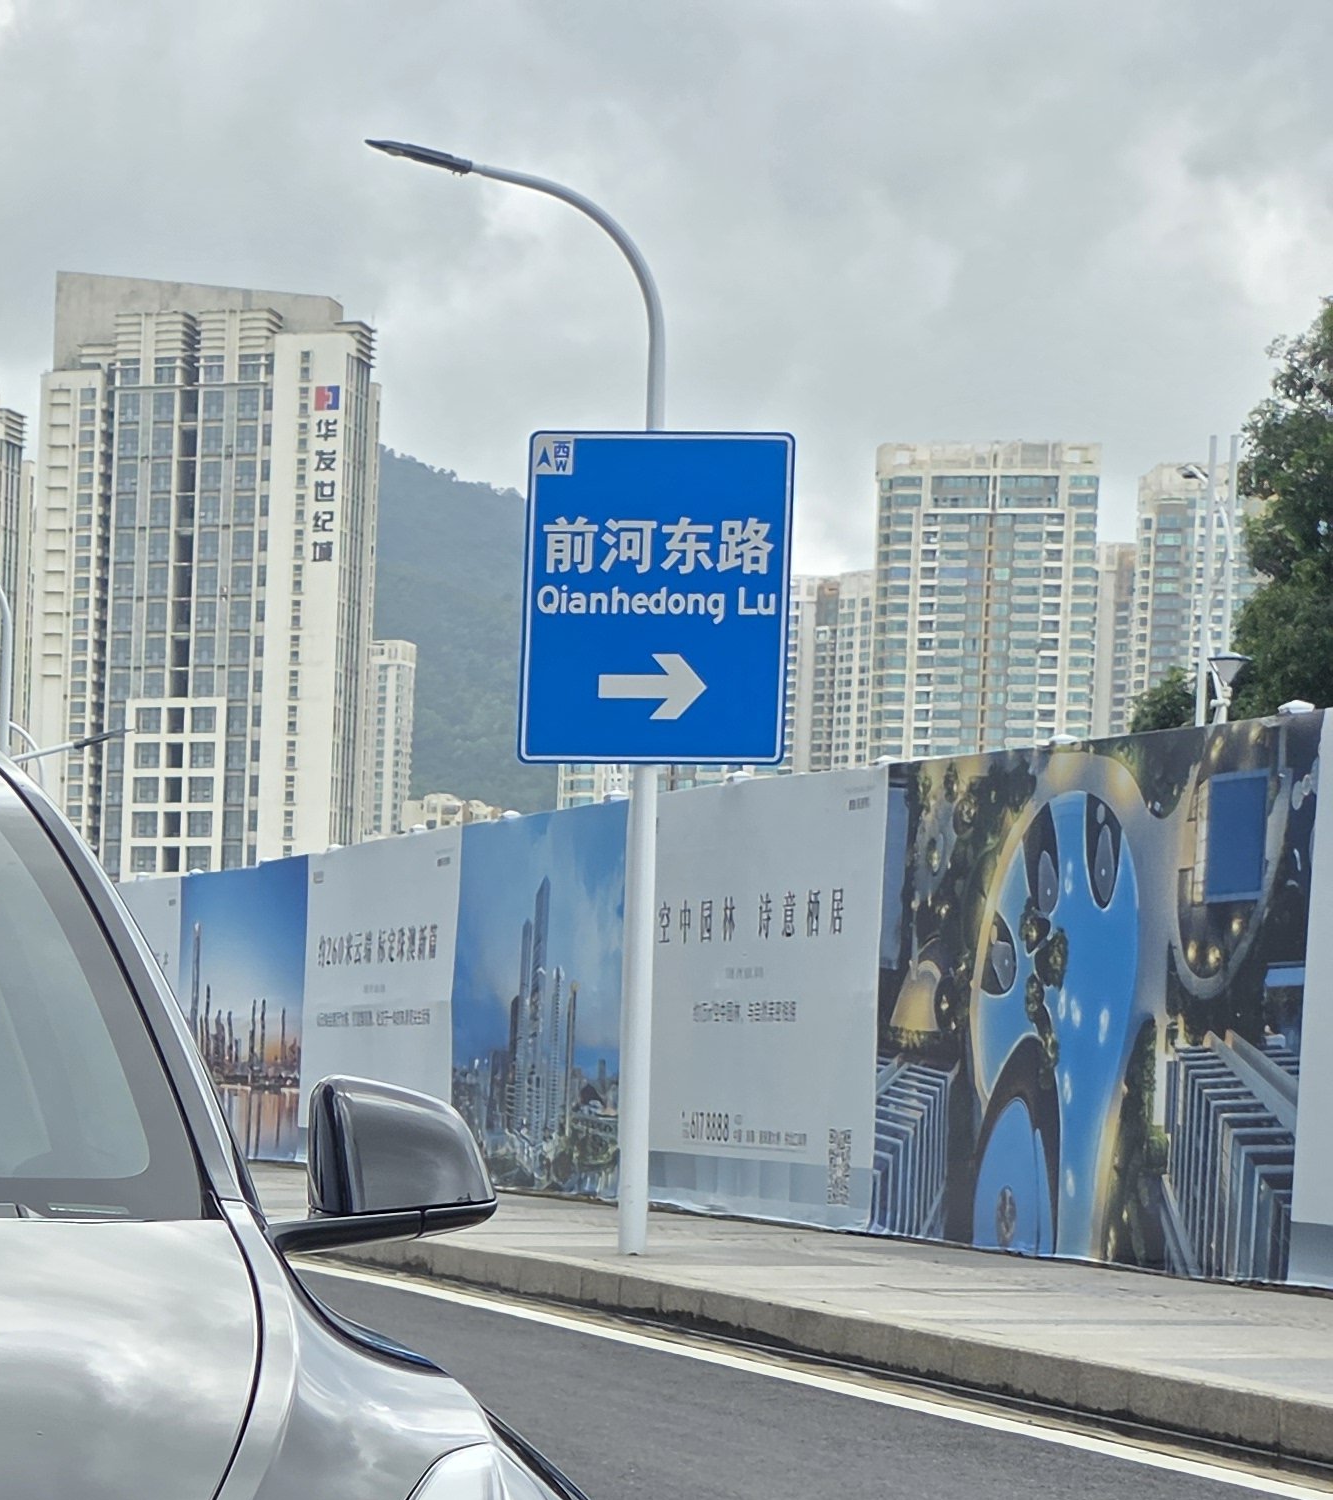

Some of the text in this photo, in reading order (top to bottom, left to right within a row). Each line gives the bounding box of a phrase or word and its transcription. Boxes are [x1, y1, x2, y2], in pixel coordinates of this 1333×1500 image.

[553, 440, 570, 458] 西
[555, 459, 568, 472] W
[311, 418, 338, 562] 华发世纪城
[542, 516, 774, 574] 前河东路
[537, 585, 776, 624] Qianhedong Lu
[658, 887, 844, 944] 空中园林 诗意栖居
